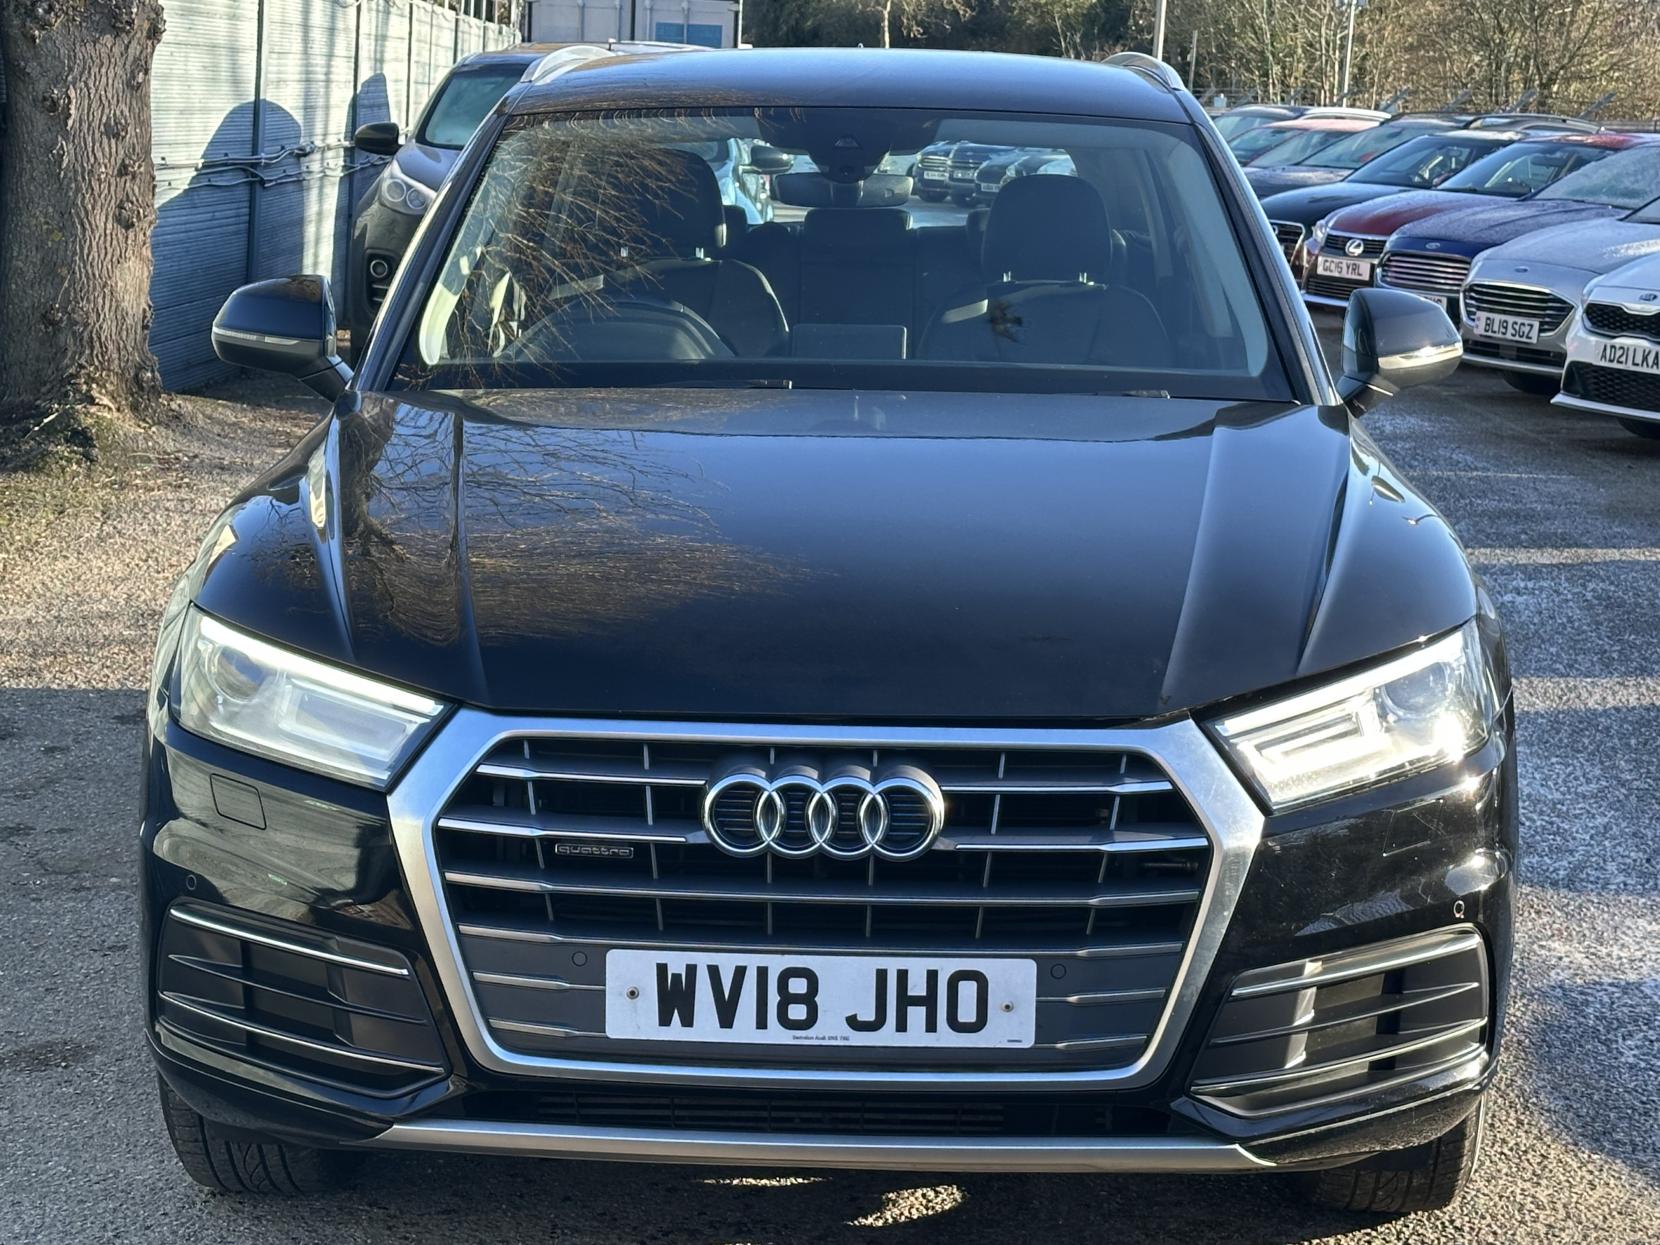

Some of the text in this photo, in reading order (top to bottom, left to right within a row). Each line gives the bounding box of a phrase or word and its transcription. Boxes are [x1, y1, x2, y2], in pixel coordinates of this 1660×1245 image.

[1345, 262, 1363, 276] YRL
[1484, 316, 1534, 340] BL19 SGZ
[1600, 344, 1660, 370] AD21 LKA
[558, 846, 630, 856] quattro
[656, 961, 989, 1034] WV18 JHO
